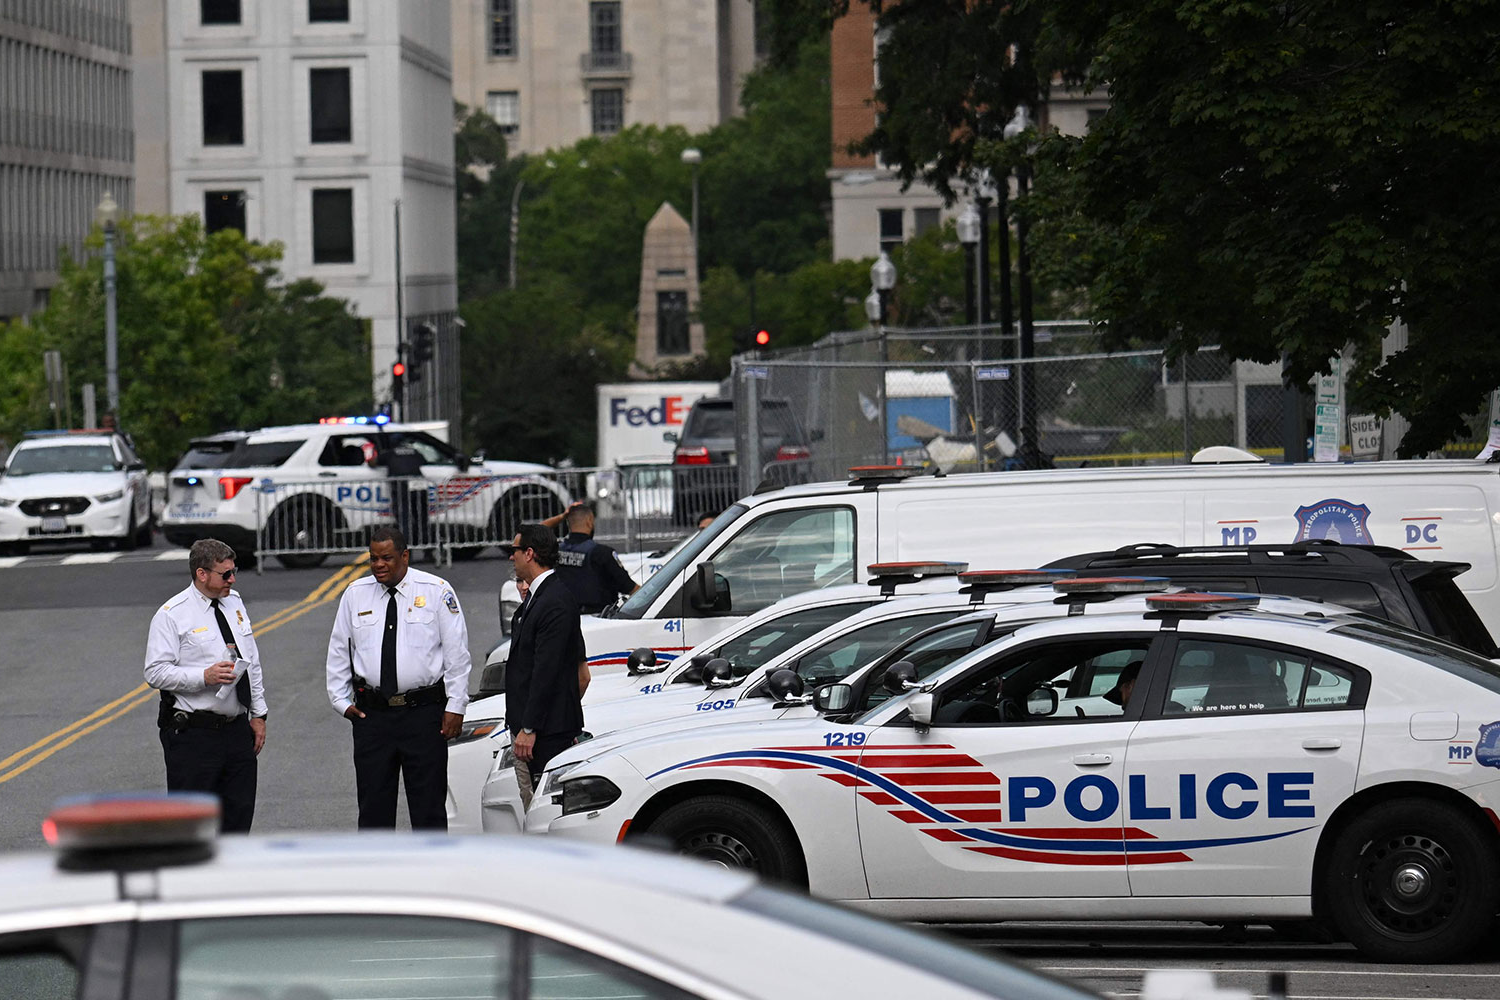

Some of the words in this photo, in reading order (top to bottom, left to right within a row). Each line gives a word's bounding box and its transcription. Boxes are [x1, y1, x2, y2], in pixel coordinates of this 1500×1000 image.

[1351, 420, 1381, 433] SIDEW
[1358, 435, 1380, 449] CLO
[1347, 512, 1363, 538] POLICE
[1220, 527, 1258, 545] MP
[1405, 524, 1438, 544] DC
[555, 556, 583, 567] OLICE
[663, 620, 681, 632] 41
[640, 683, 662, 694] 48
[696, 698, 736, 711] 1505
[1249, 702, 1265, 711] help
[823, 731, 866, 747] 1219
[1448, 745, 1474, 759] MP
[1007, 771, 1316, 822] POLICE
